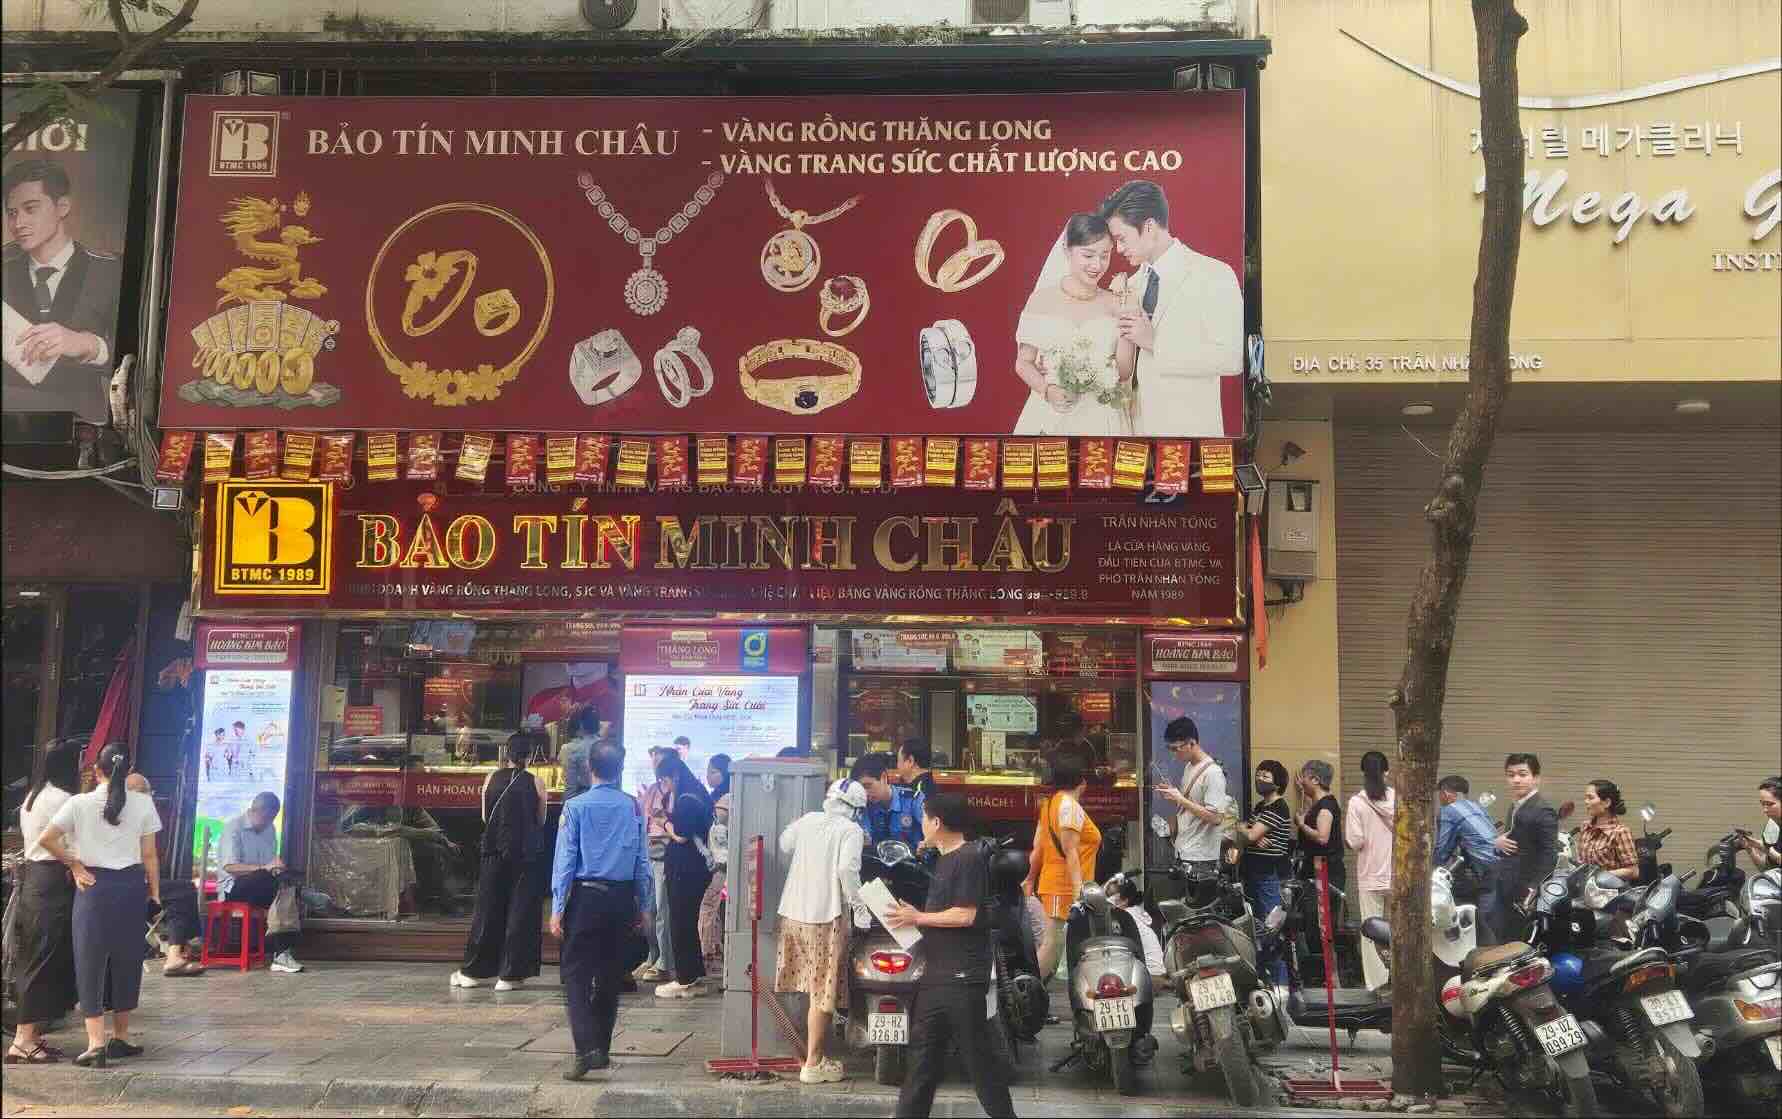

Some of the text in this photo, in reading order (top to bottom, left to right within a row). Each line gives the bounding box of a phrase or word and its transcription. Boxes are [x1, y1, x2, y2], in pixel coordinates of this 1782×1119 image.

[306, 121, 680, 156] BẢO TÍN MINH CHÂU
[722, 118, 794, 143] VÀNG
[800, 113, 877, 142] RỒNG
[882, 114, 972, 142] THĂNG
[979, 120, 1052, 141] LONG
[720, 149, 792, 175] VÀNG
[799, 152, 885, 175] TRANG
[892, 148, 942, 174] SỨC
[948, 142, 1017, 173] CHẤT
[1024, 150, 1118, 178] LƯỢNG
[1124, 150, 1184, 172] CAO
[1474, 169, 1696, 244] Mega
[1293, 357, 1321, 375] ĐỊA
[1366, 358, 1383, 370] 35
[1391, 351, 1433, 370] TRẦN
[1507, 355, 1543, 369] ÔNG
[356, 494, 1076, 572] BẢO TÍN MINH CHÂU
[231, 568, 315, 581] BTMC 1989
[421, 581, 453, 596] VÀNG
[874, 584, 906, 599] VÀNG
[990, 588, 1023, 600] LONG
[1161, 590, 1184, 600] 1989
[444, 785, 474, 794] HOAN
[1546, 1030, 1583, 1054] 099.29
